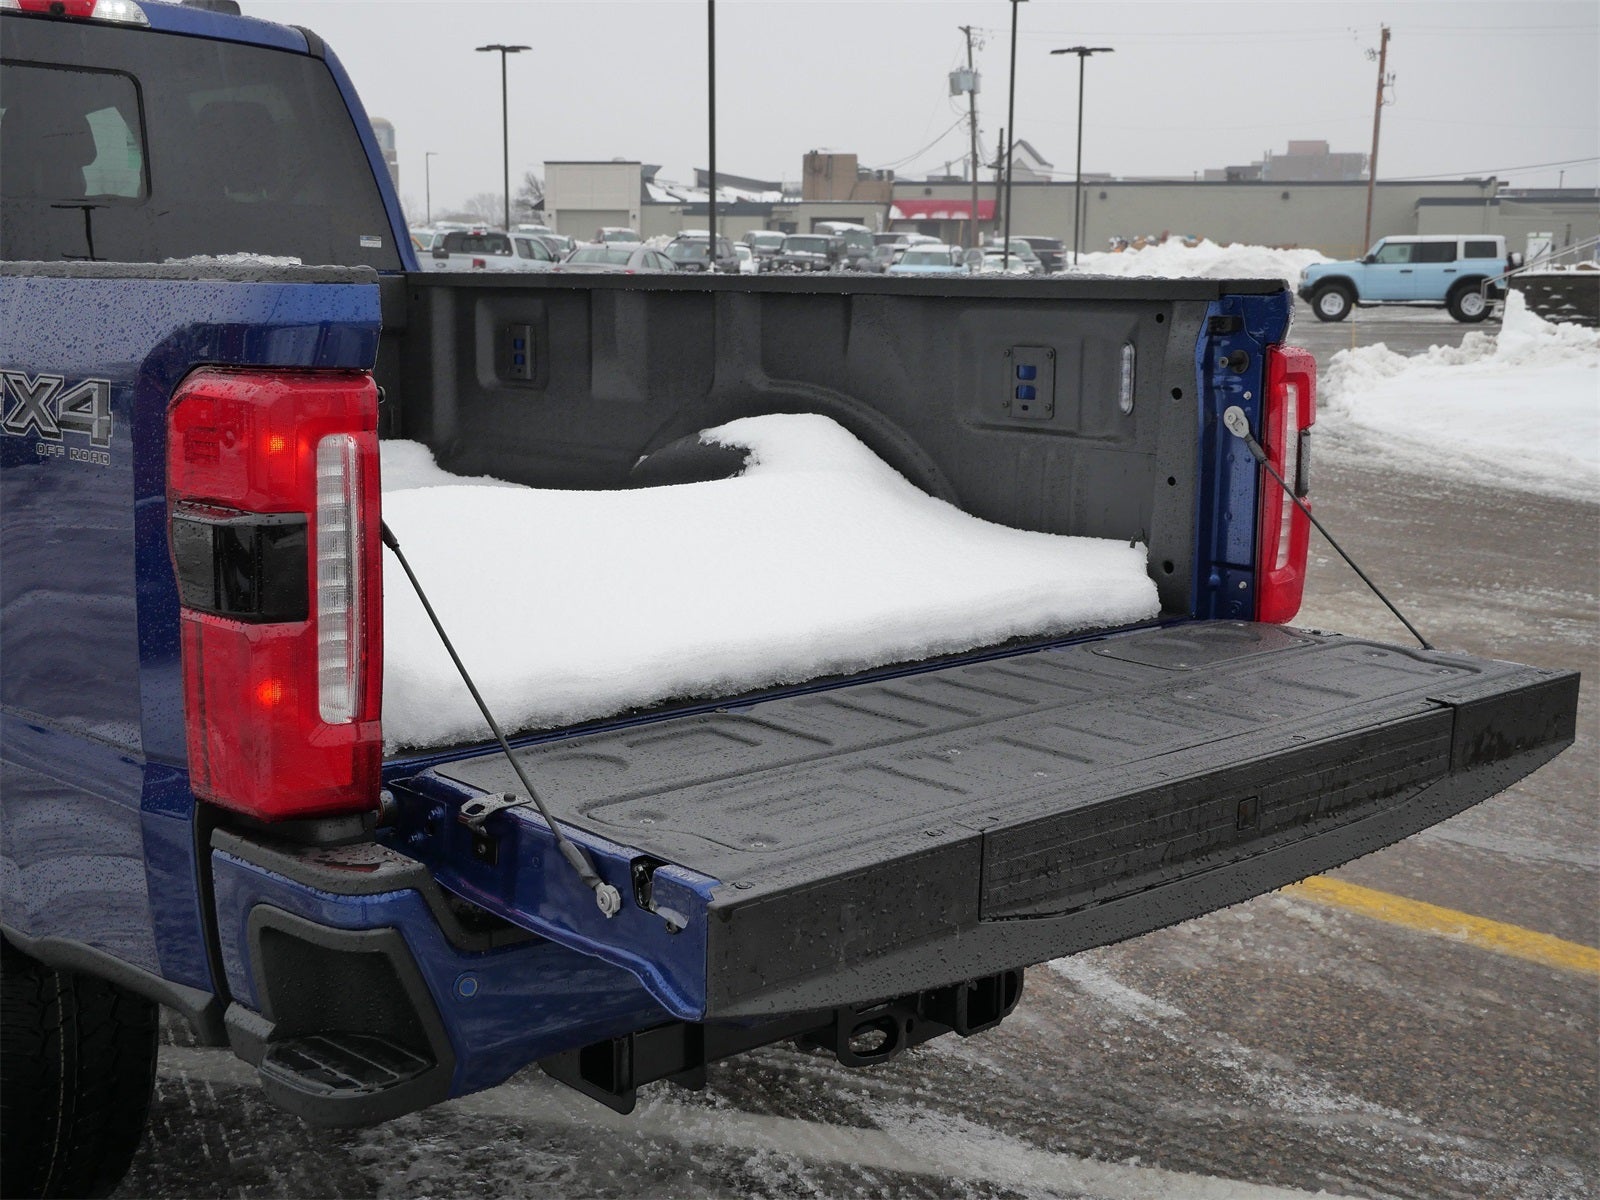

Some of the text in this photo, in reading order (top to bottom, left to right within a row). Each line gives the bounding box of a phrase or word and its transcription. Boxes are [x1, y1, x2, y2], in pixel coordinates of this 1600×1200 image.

[0, 370, 113, 448] X4
[36, 442, 111, 466] OFF ROAD
